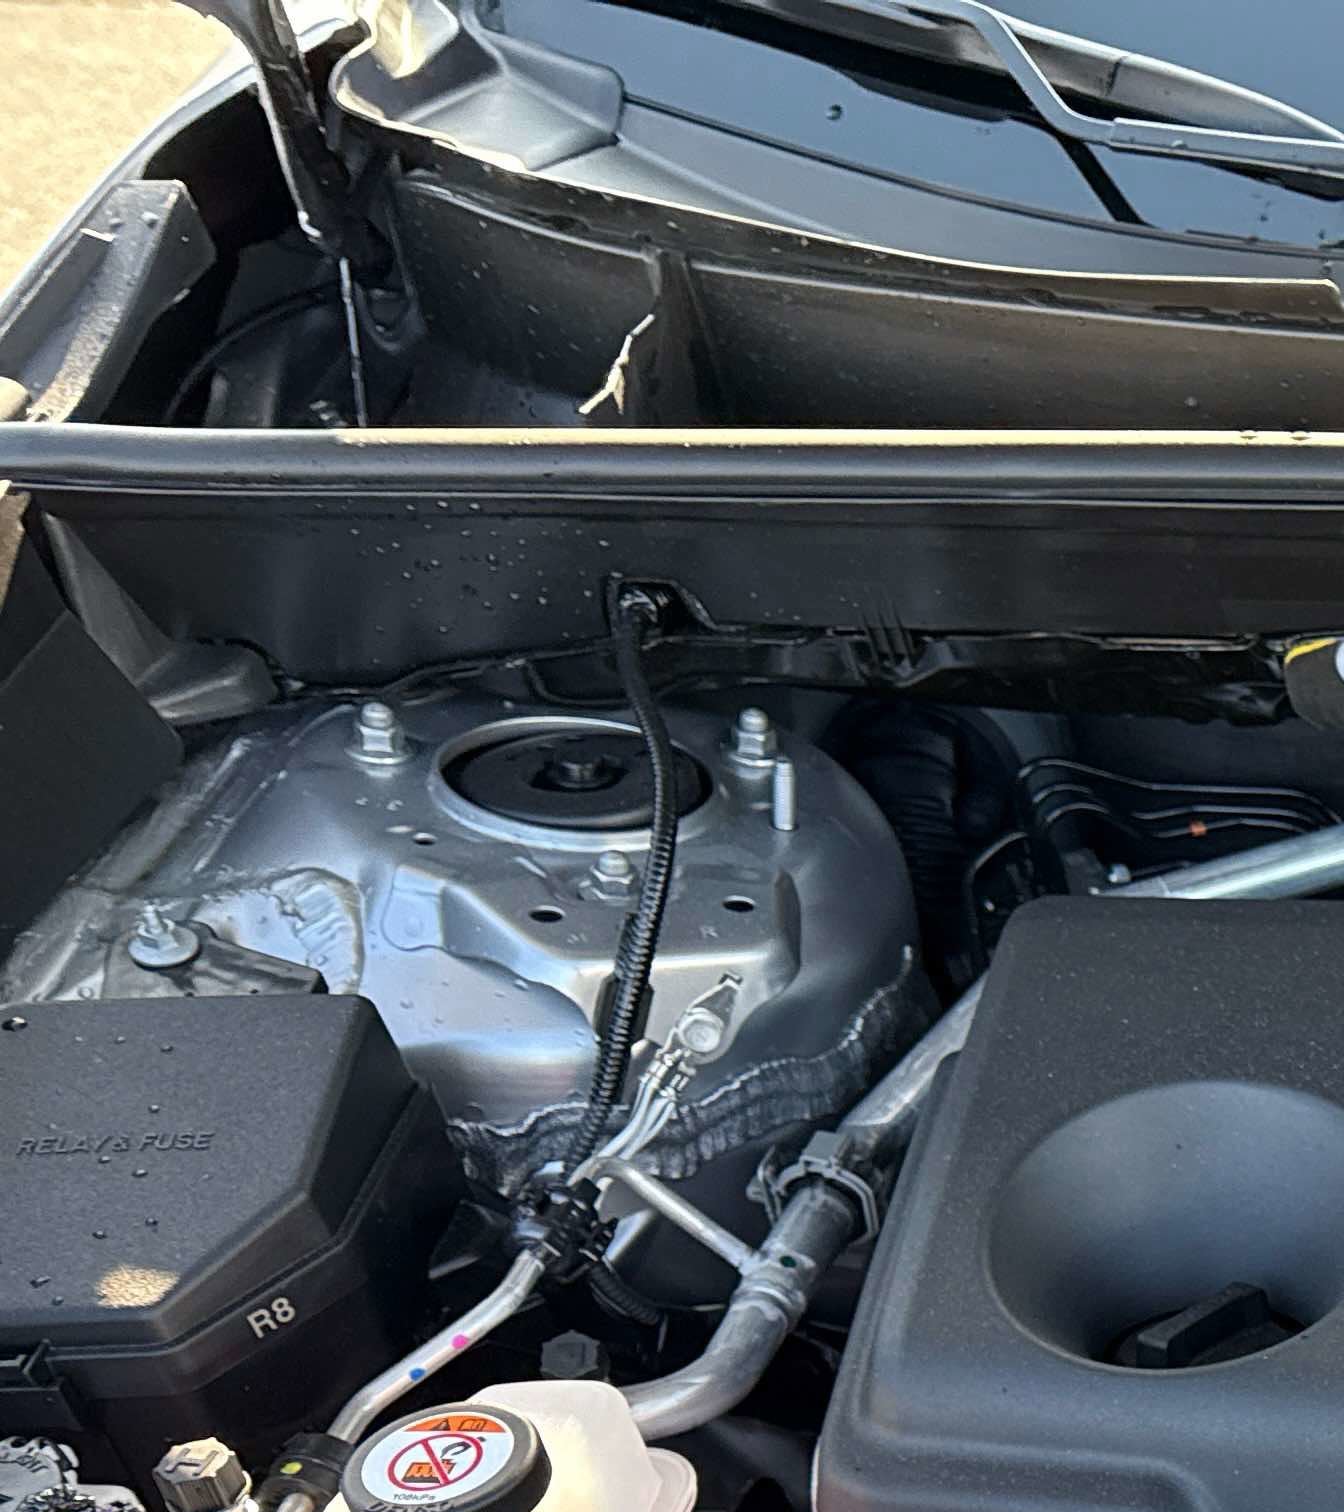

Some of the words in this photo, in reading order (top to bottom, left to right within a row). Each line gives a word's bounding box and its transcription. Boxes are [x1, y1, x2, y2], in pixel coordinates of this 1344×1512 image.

[16, 1135, 112, 1156] RELAY
[138, 1131, 216, 1151] FUSE
[247, 1297, 296, 1339] R8
